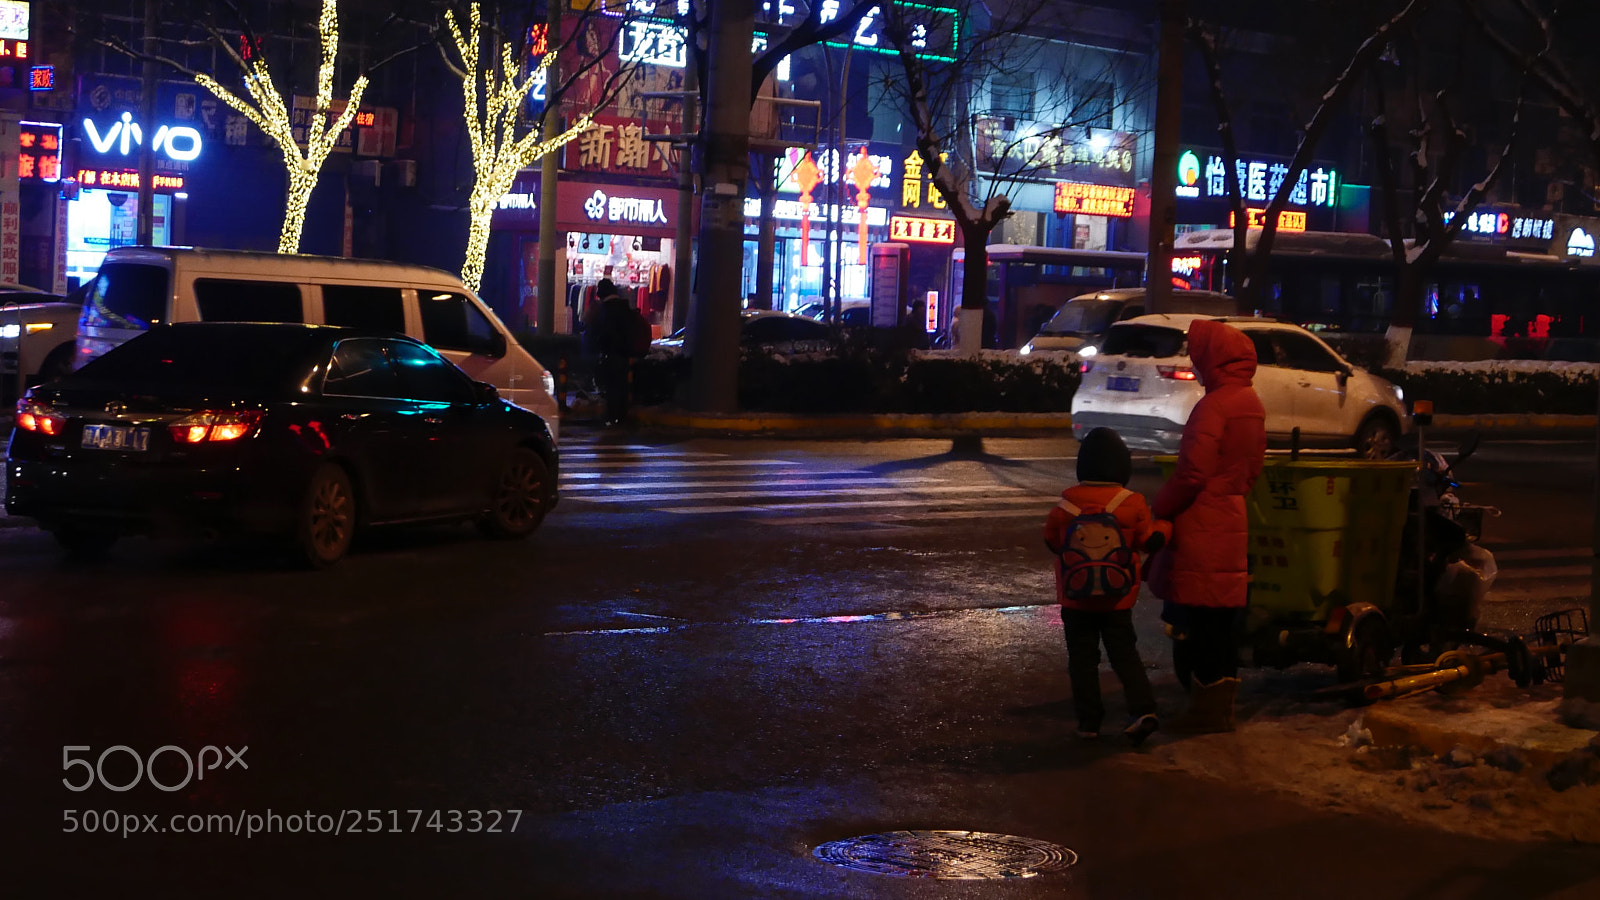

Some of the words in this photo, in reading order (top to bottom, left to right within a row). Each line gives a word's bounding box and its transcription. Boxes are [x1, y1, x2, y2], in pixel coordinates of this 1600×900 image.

[33, 68, 52, 87] 家政
[356, 112, 375, 126] 住宿
[83, 111, 202, 160] vivo
[903, 178, 947, 209] 网吧
[609, 197, 667, 223] 都市丽人
